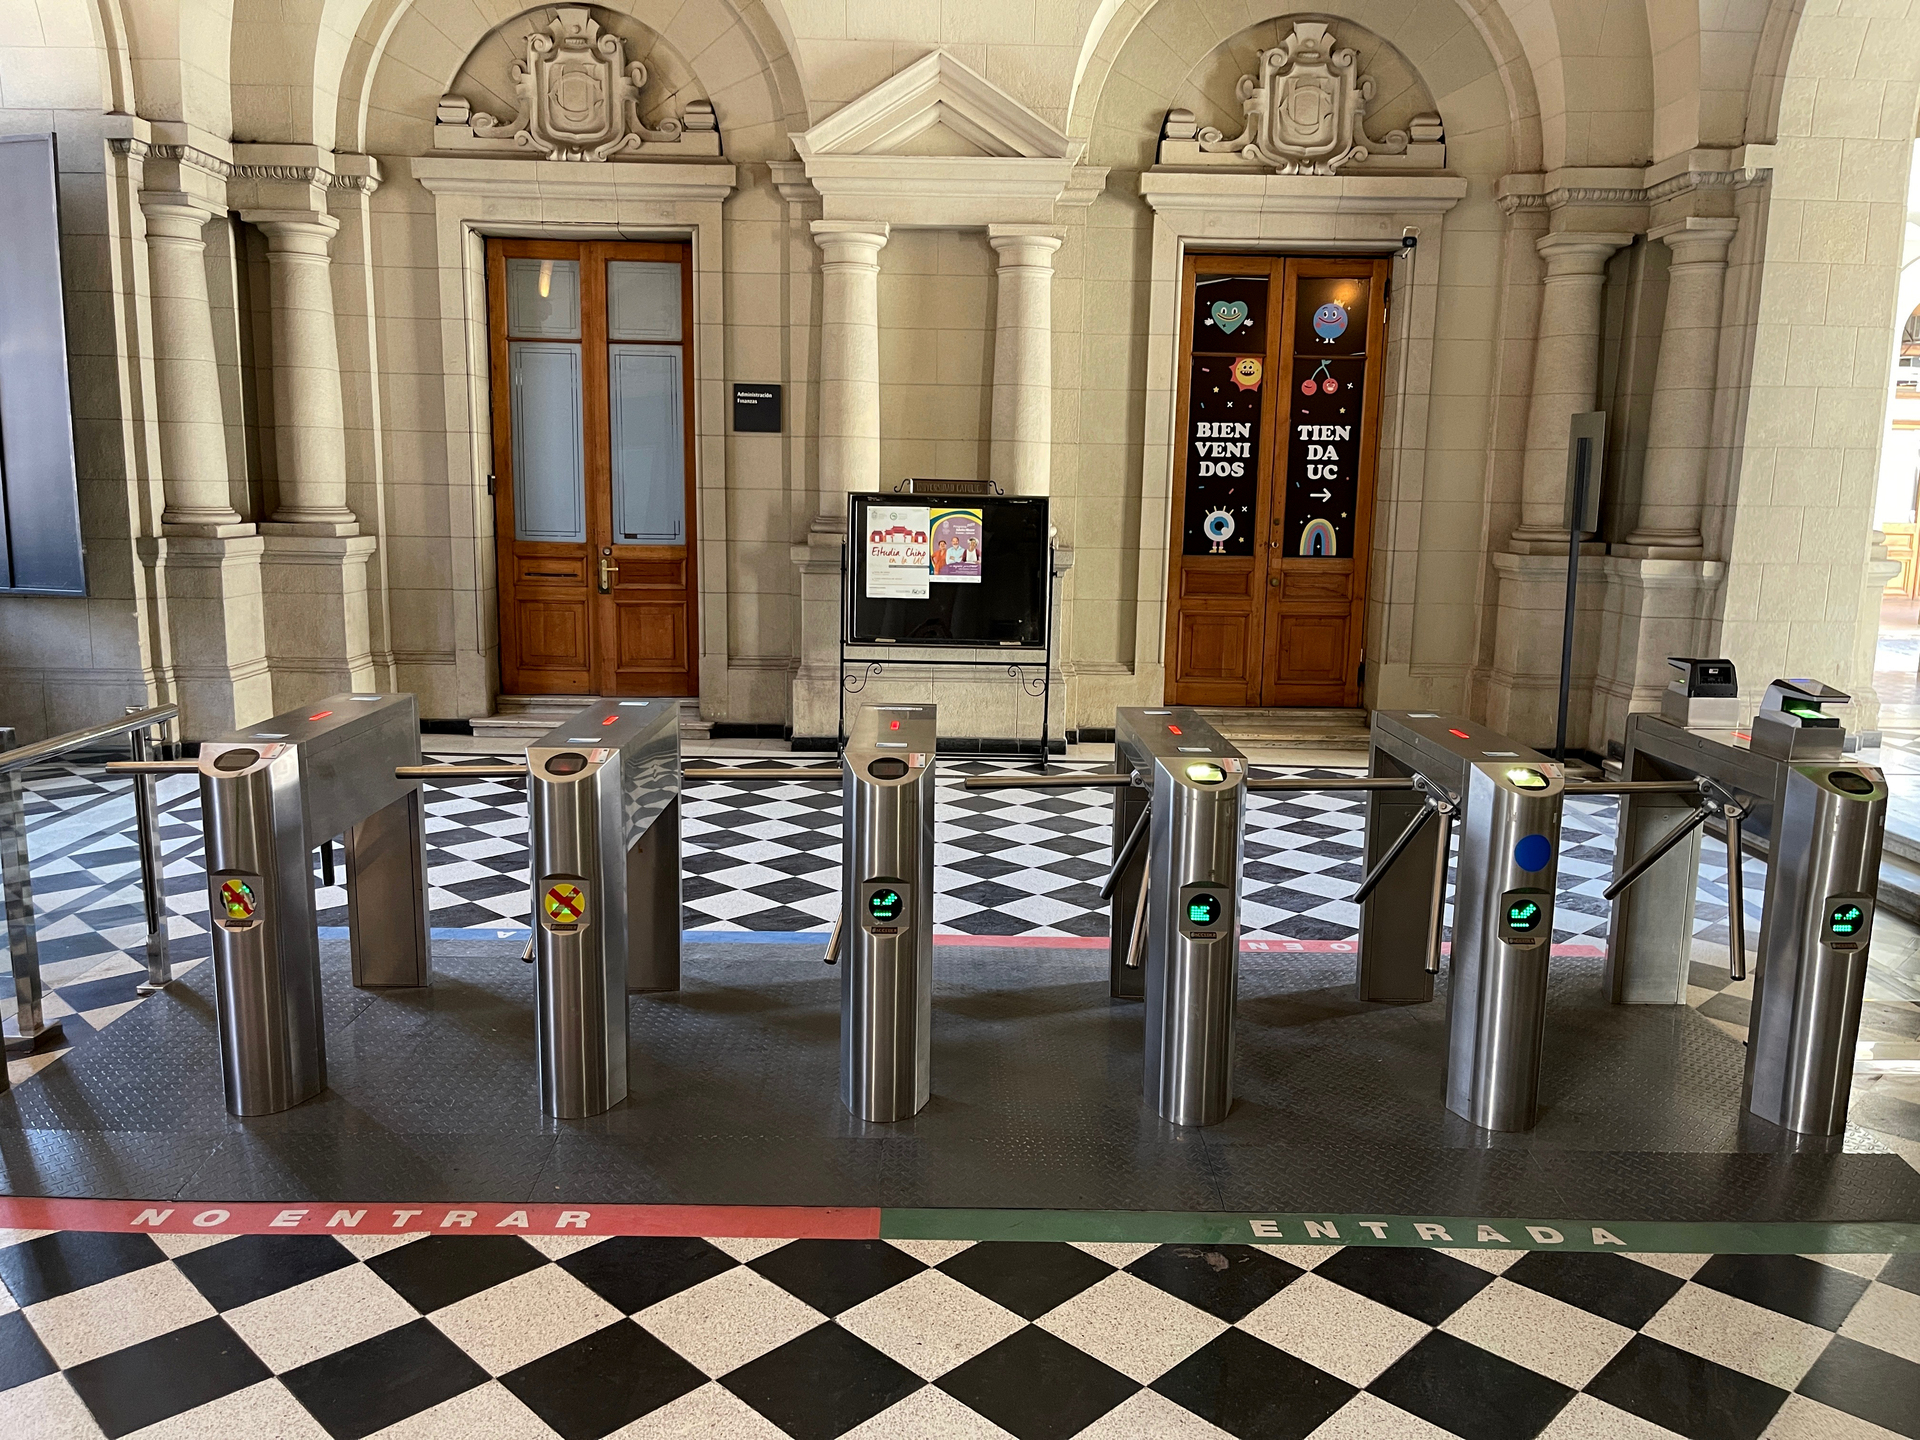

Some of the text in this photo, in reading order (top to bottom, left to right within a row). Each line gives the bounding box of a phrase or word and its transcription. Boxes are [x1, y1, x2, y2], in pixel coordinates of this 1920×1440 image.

[1196, 422, 1252, 439] BIEN
[1297, 425, 1352, 441] TIEN
[1195, 441, 1251, 458] VENI
[1306, 445, 1339, 461] DA
[1198, 461, 1245, 478] DOS
[1306, 464, 1339, 480] UC
[871, 546, 927, 557] Estudia Chino
[912, 556, 926, 565] UC
[130, 1208, 591, 1228] NO ENTRAR
[1248, 1219, 1628, 1246] ENTRADA
